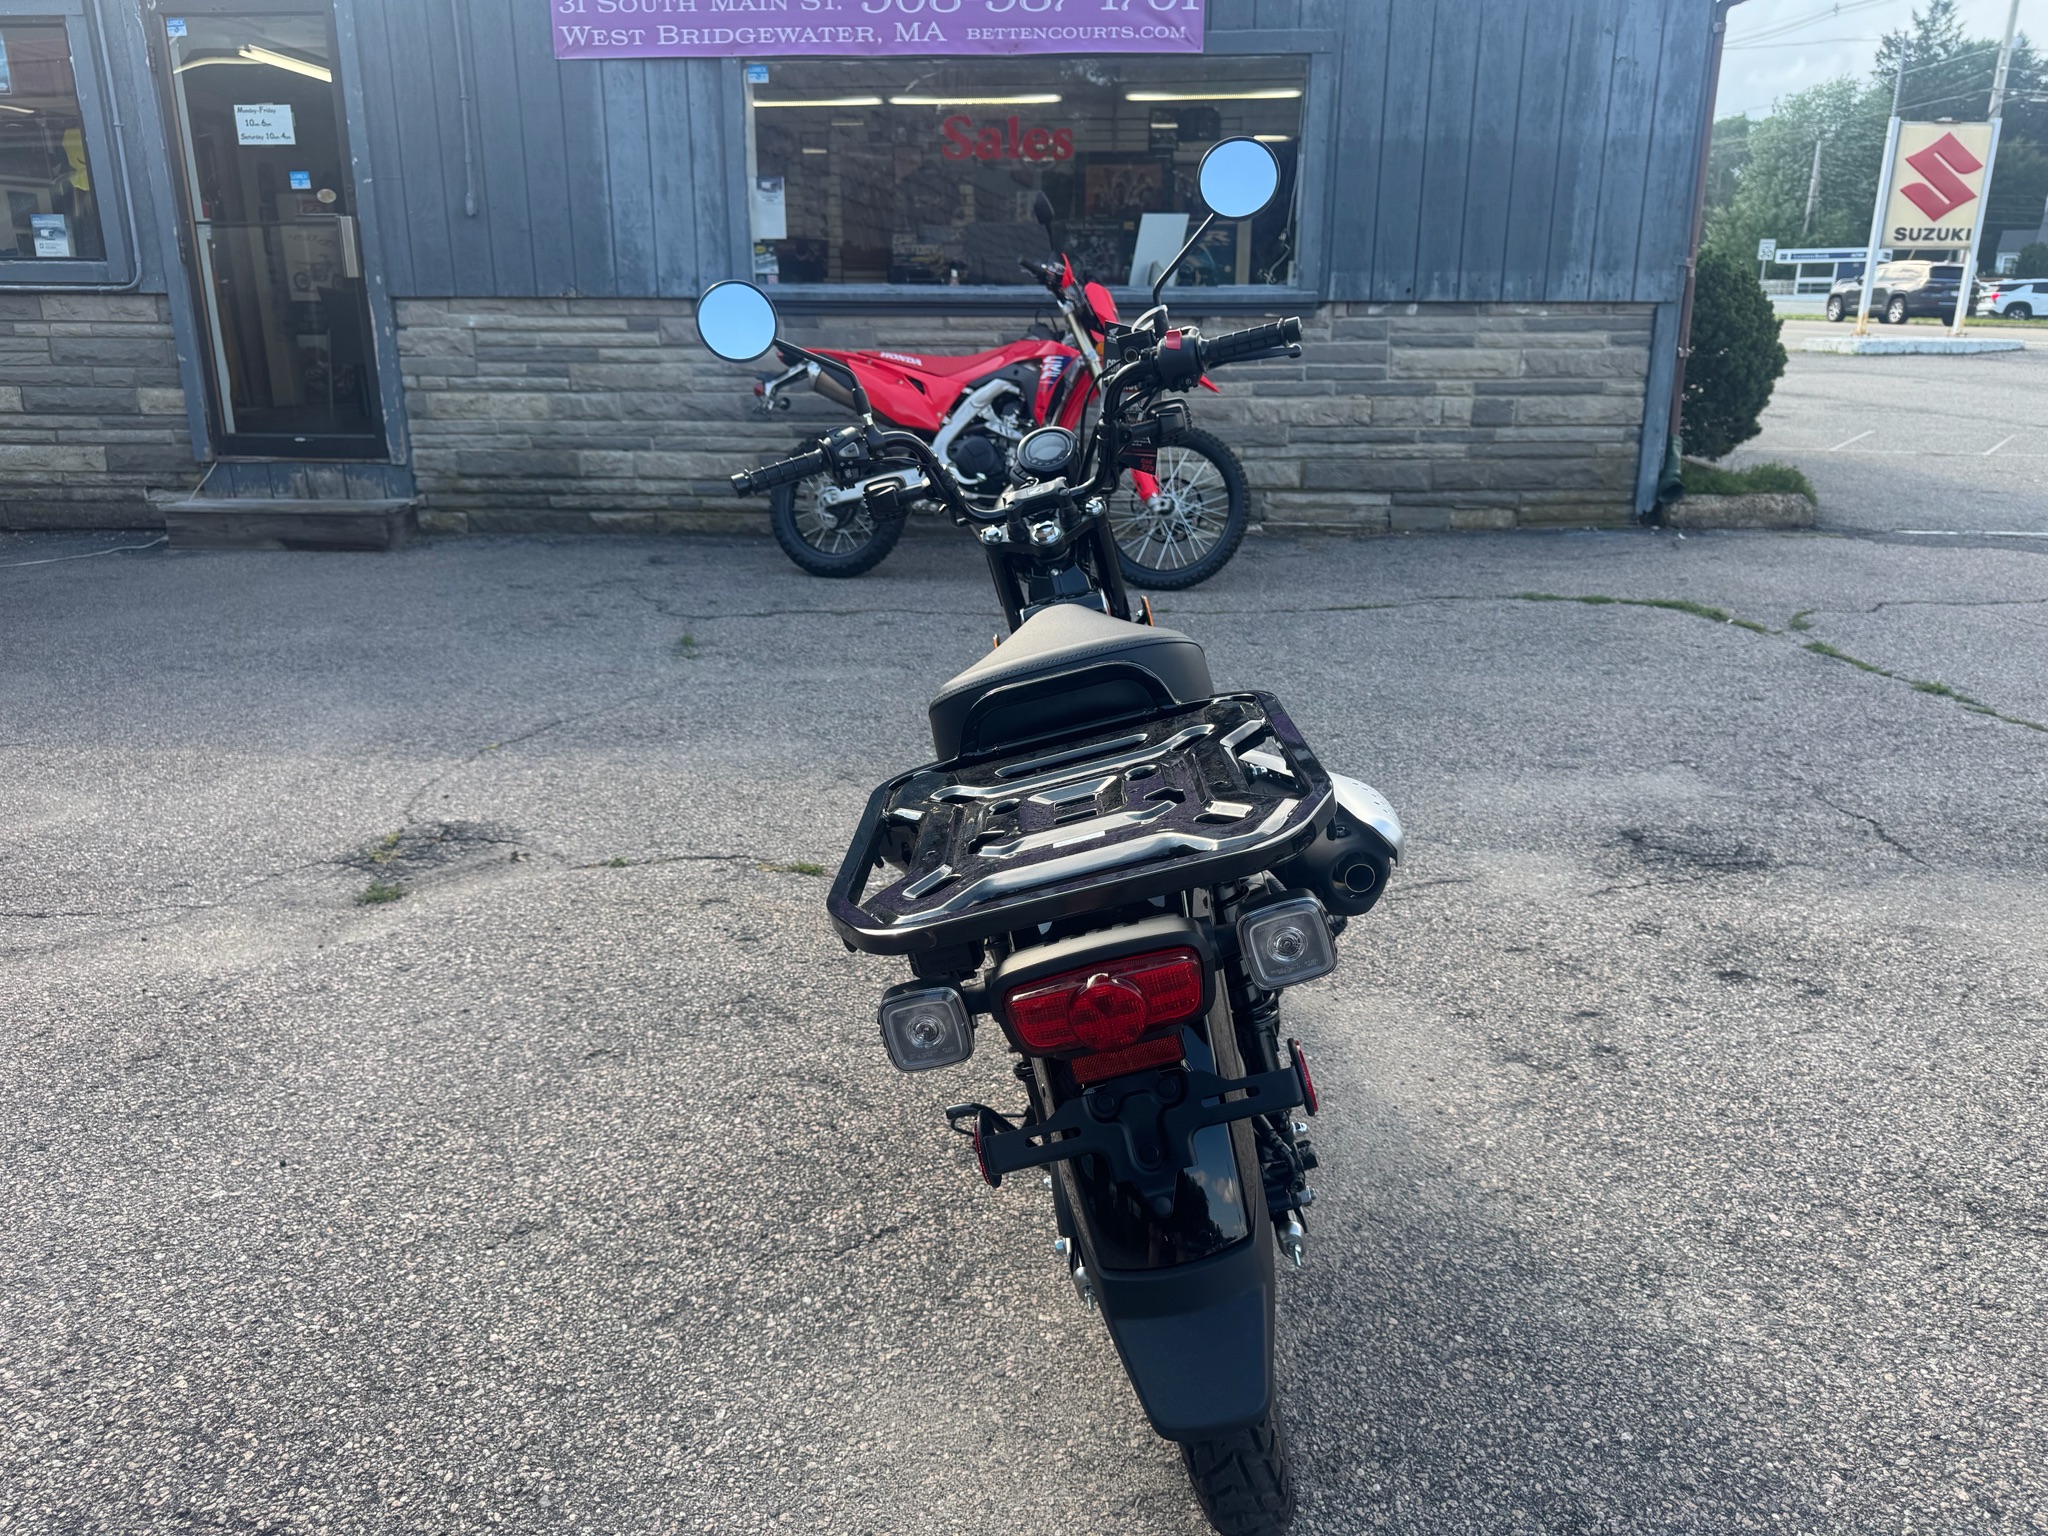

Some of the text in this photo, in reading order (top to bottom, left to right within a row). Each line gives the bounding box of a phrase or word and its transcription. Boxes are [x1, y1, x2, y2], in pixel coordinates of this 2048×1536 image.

[558, 25, 646, 46] WEST
[894, 22, 948, 42] MA
[966, 26, 1187, 40] BETTENCOURTS.COM
[941, 114, 1075, 160] Sales
[1893, 227, 1972, 242] SUZUKI
[880, 351, 922, 366] HONDA
